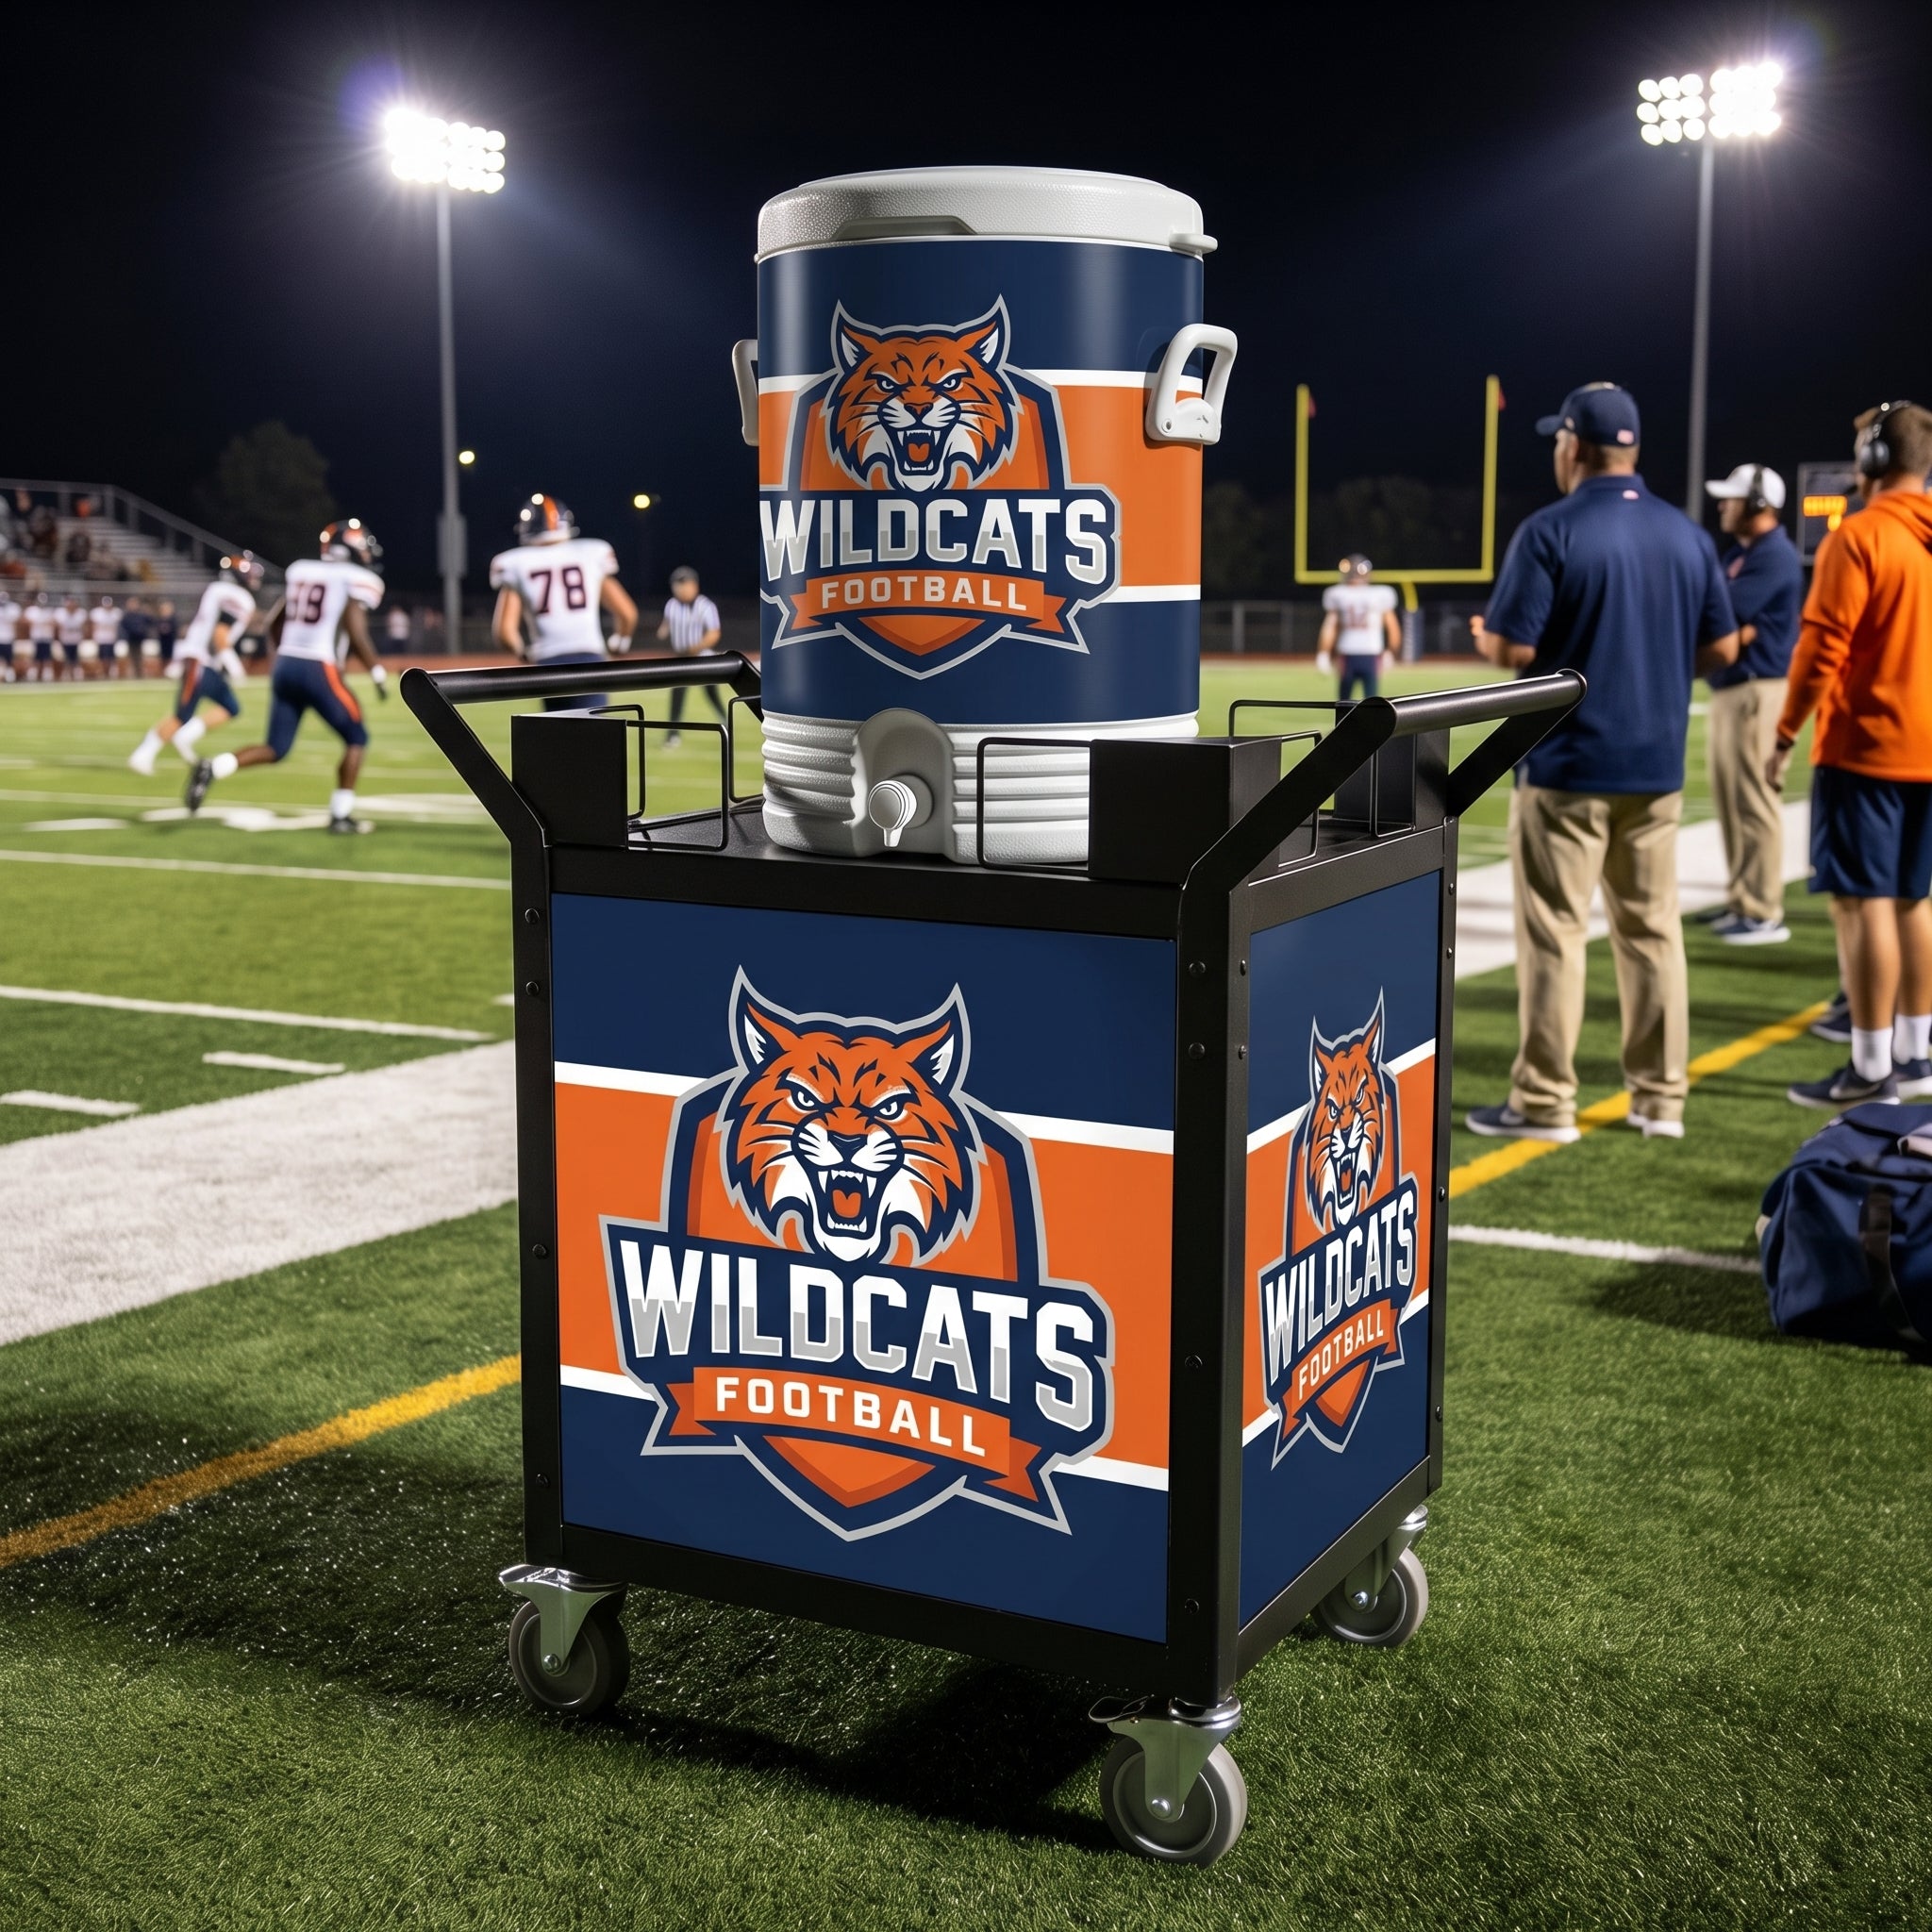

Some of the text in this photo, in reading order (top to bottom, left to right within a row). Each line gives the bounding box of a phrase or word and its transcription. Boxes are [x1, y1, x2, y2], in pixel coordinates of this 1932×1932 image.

[759, 499, 1108, 584] WILDCATS
[529, 566, 586, 614] 78
[823, 576, 1026, 610] FOOTBALL
[1265, 1190, 1414, 1386] WILDCATS
[619, 1240, 1094, 1432] WILDCATS
[1298, 1309, 1384, 1400] FOOTBALL
[716, 1377, 986, 1457] FOOTBALL
